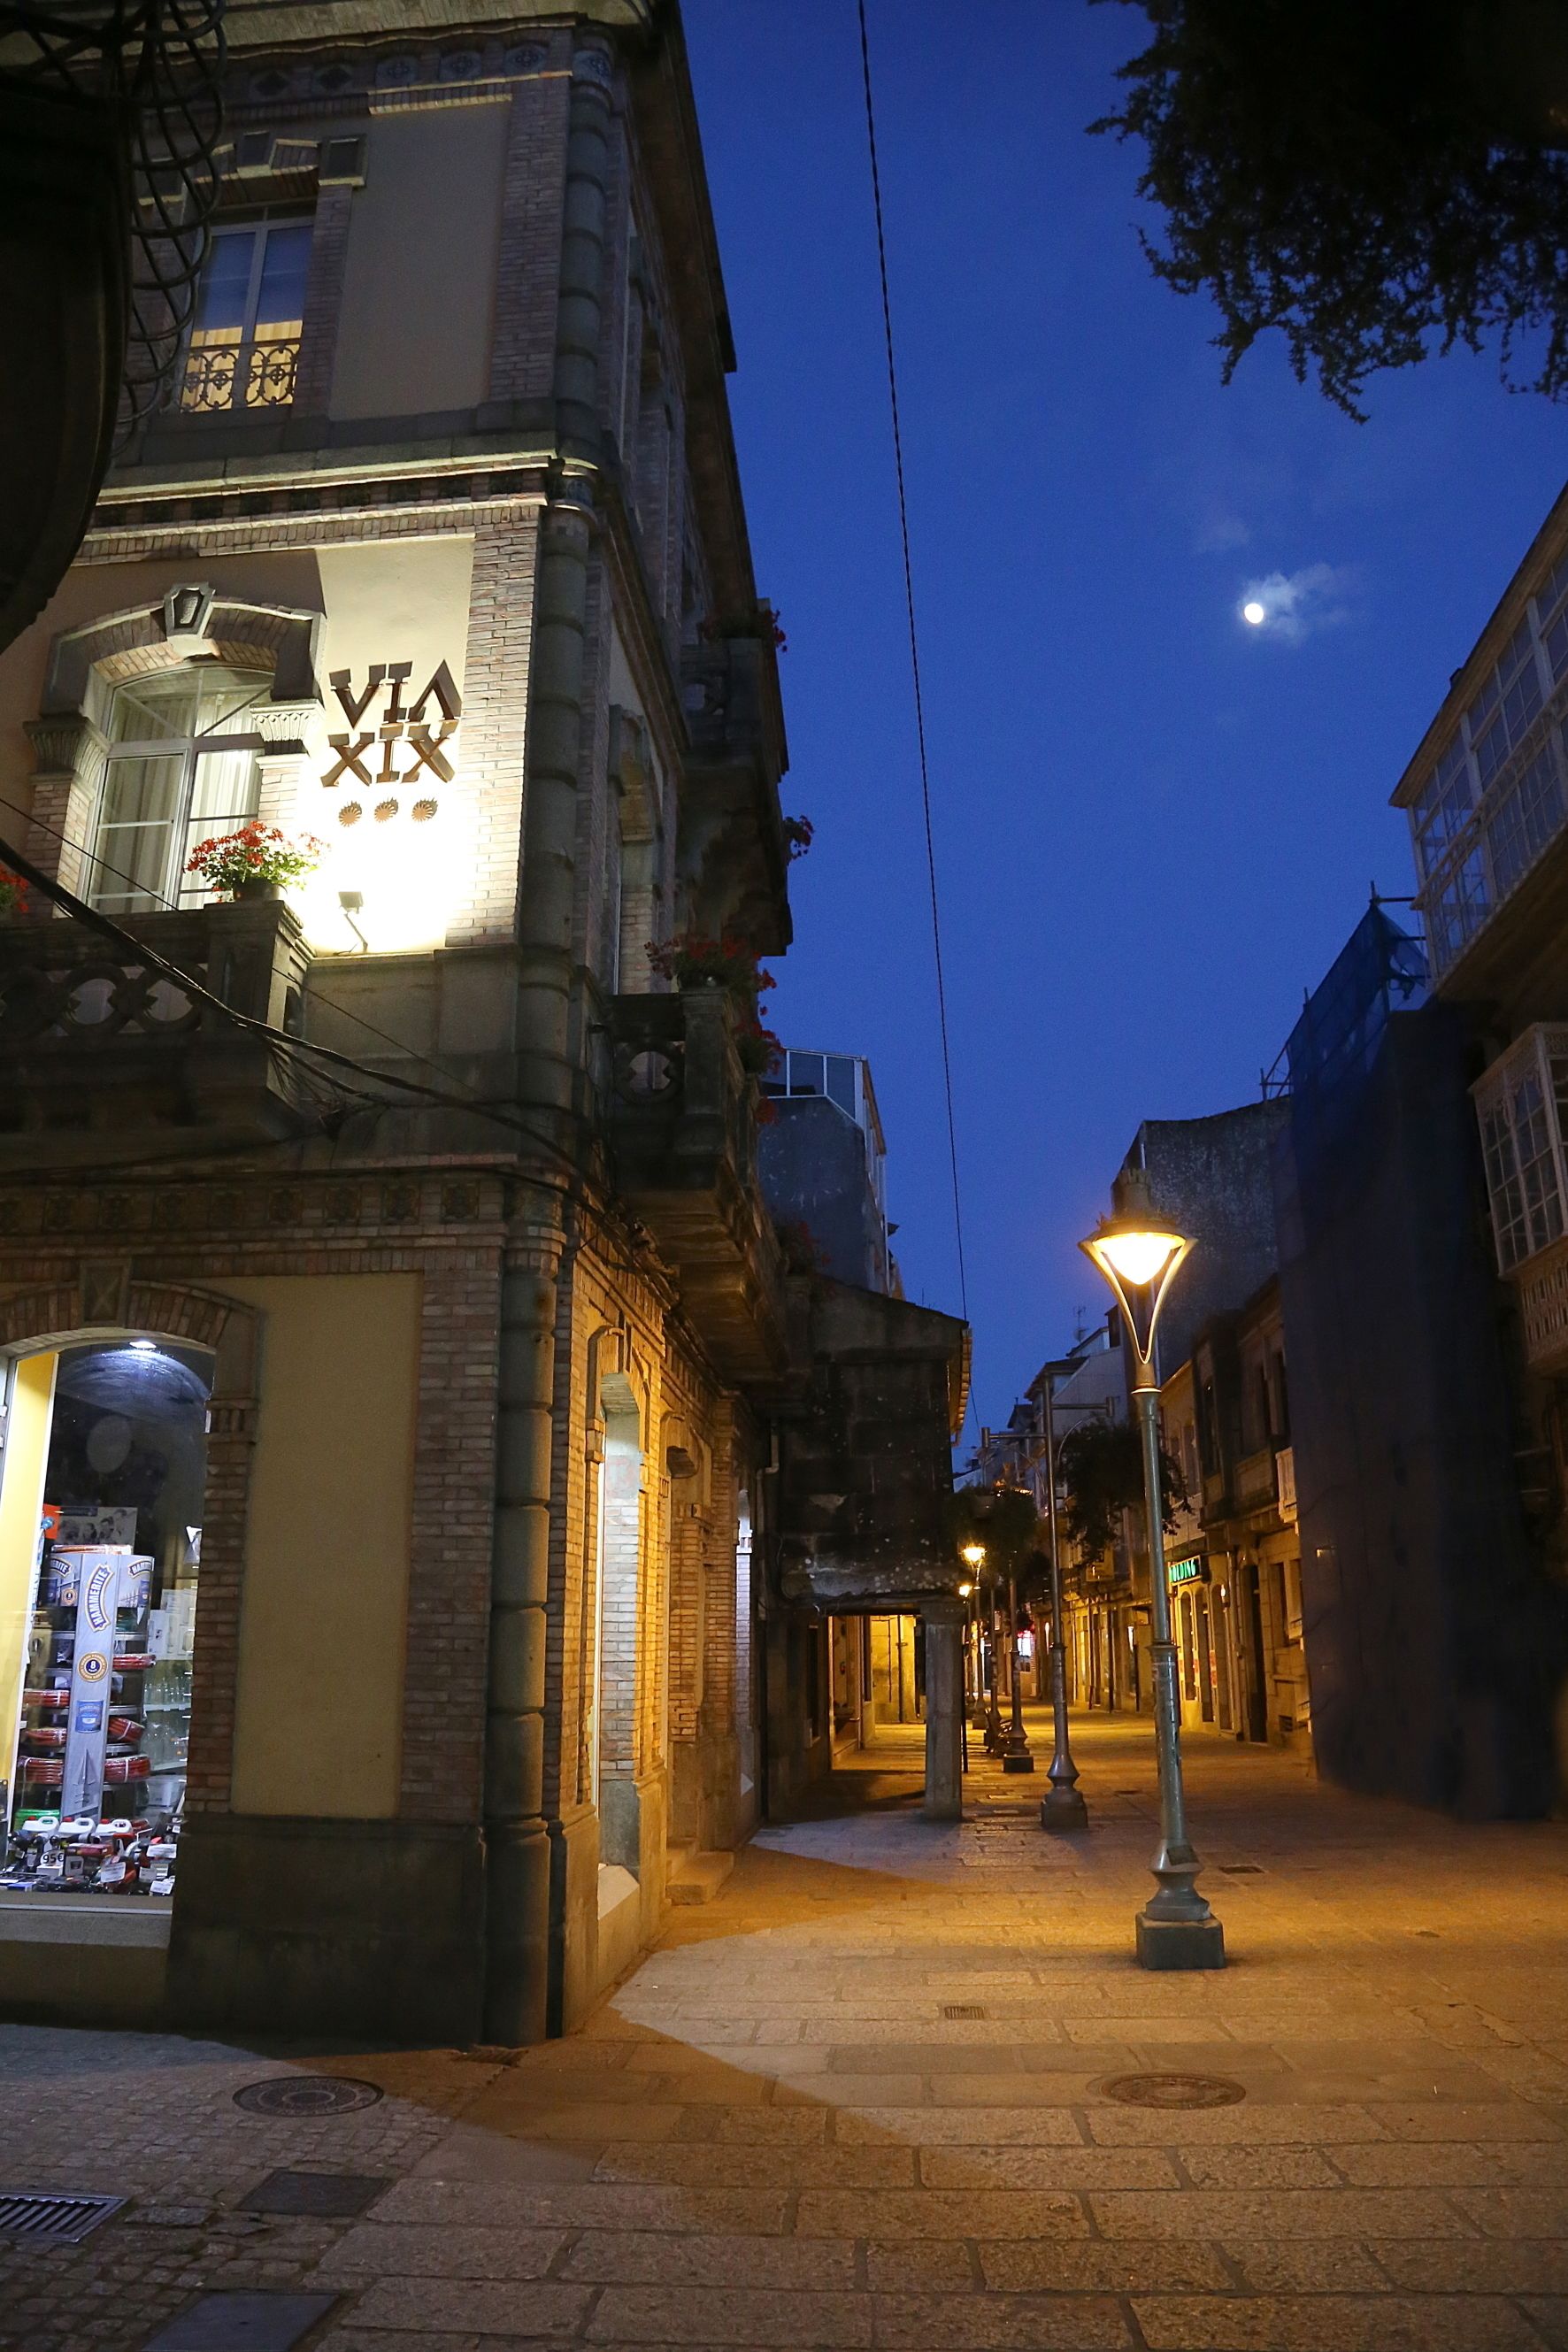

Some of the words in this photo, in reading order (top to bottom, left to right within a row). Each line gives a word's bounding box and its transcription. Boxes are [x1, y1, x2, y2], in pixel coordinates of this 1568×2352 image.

[328, 659, 462, 729] VIA
[320, 720, 458, 788] XIX
[88, 1568, 108, 1626] HAMMERITE
[90, 1660, 96, 1670] 8
[42, 1852, 65, 1864] 95€
